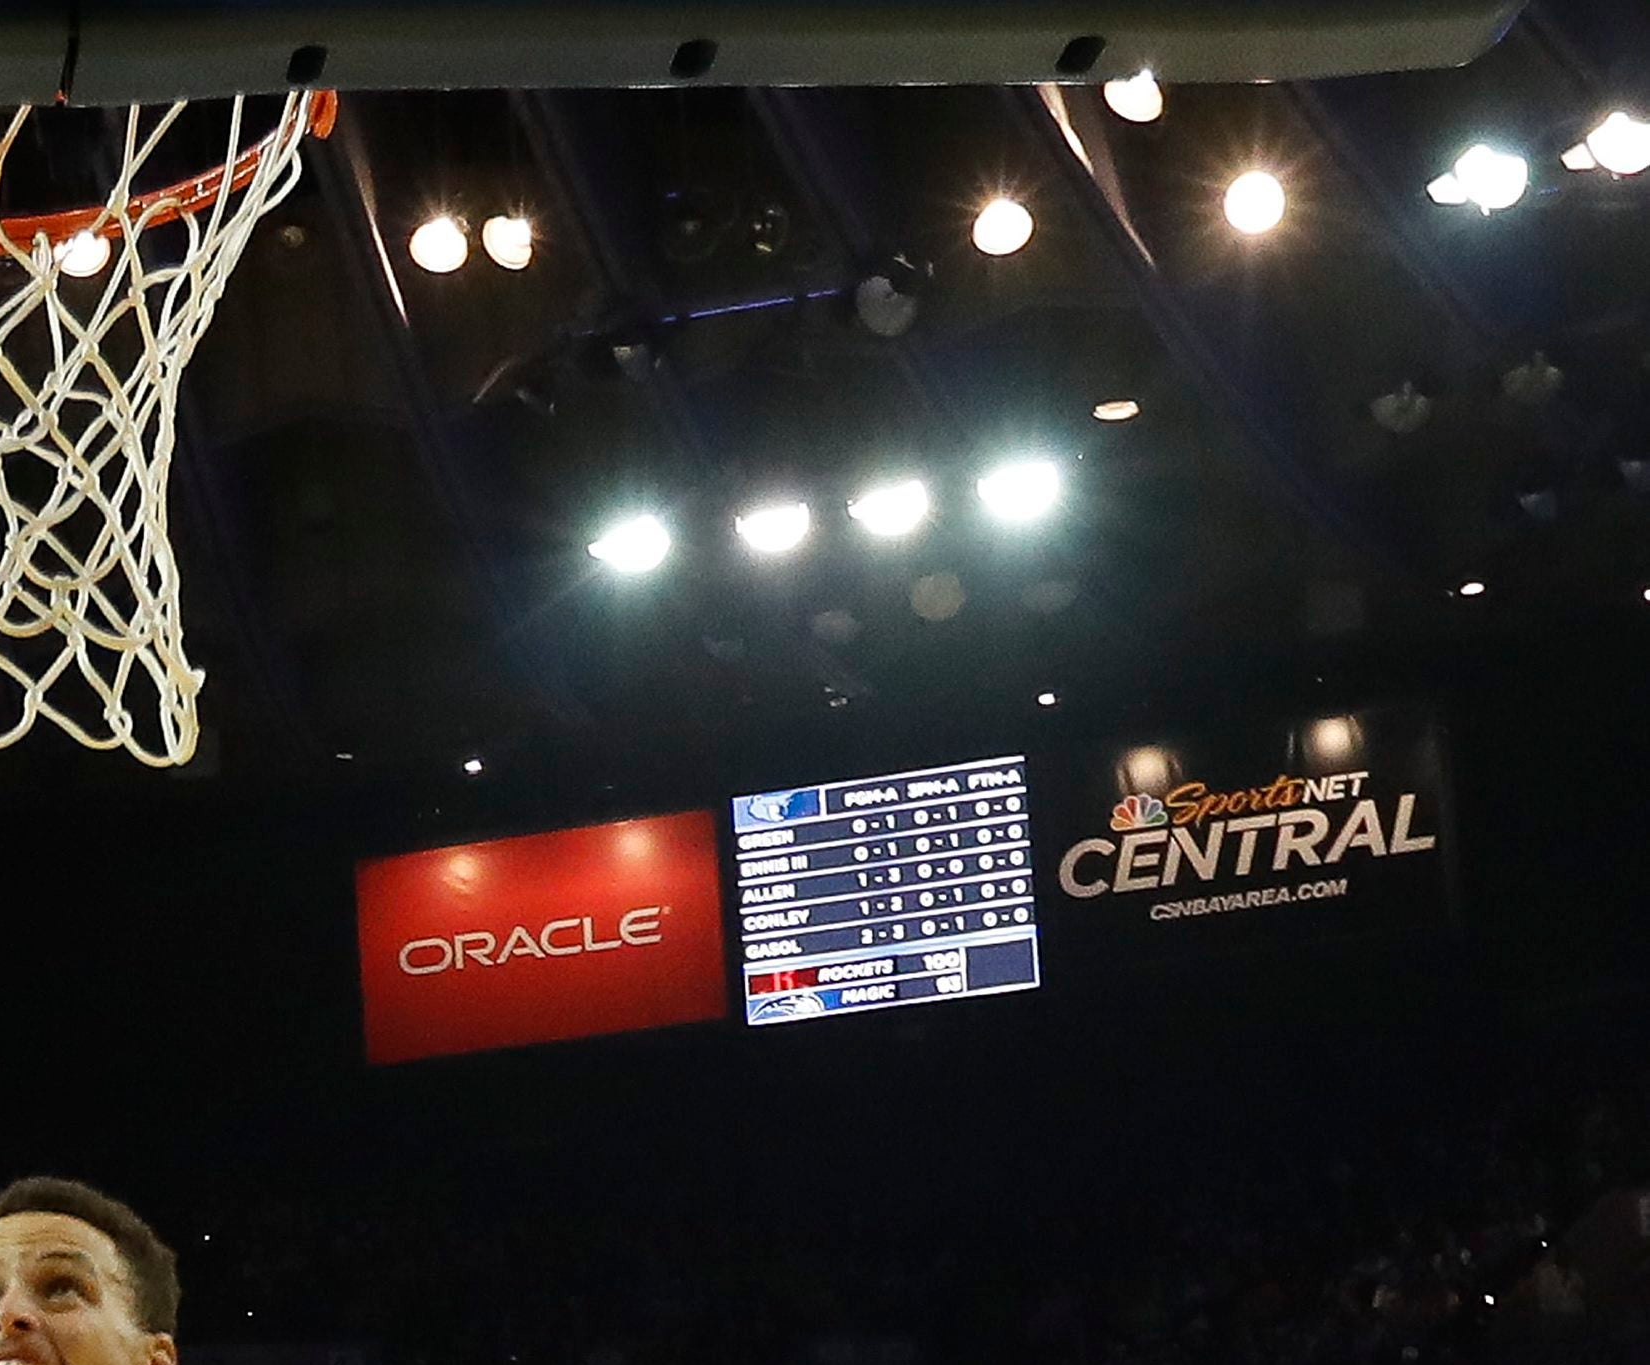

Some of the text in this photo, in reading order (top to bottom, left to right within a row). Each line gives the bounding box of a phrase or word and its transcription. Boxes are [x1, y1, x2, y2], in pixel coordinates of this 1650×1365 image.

[738, 829, 794, 850] GREEN
[1059, 794, 1435, 898] CENTRAL
[740, 857, 790, 878] ENNIS
[790, 854, 808, 870] III
[742, 884, 796, 904] ALLEN
[1151, 878, 1348, 920] CSNBAYAREA.COM
[743, 909, 811, 931] CONLEY
[399, 906, 662, 975] ORACLE
[745, 940, 802, 960] GASOL
[817, 951, 961, 983] ROCKETS 100
[840, 984, 896, 1005] MAGIC
